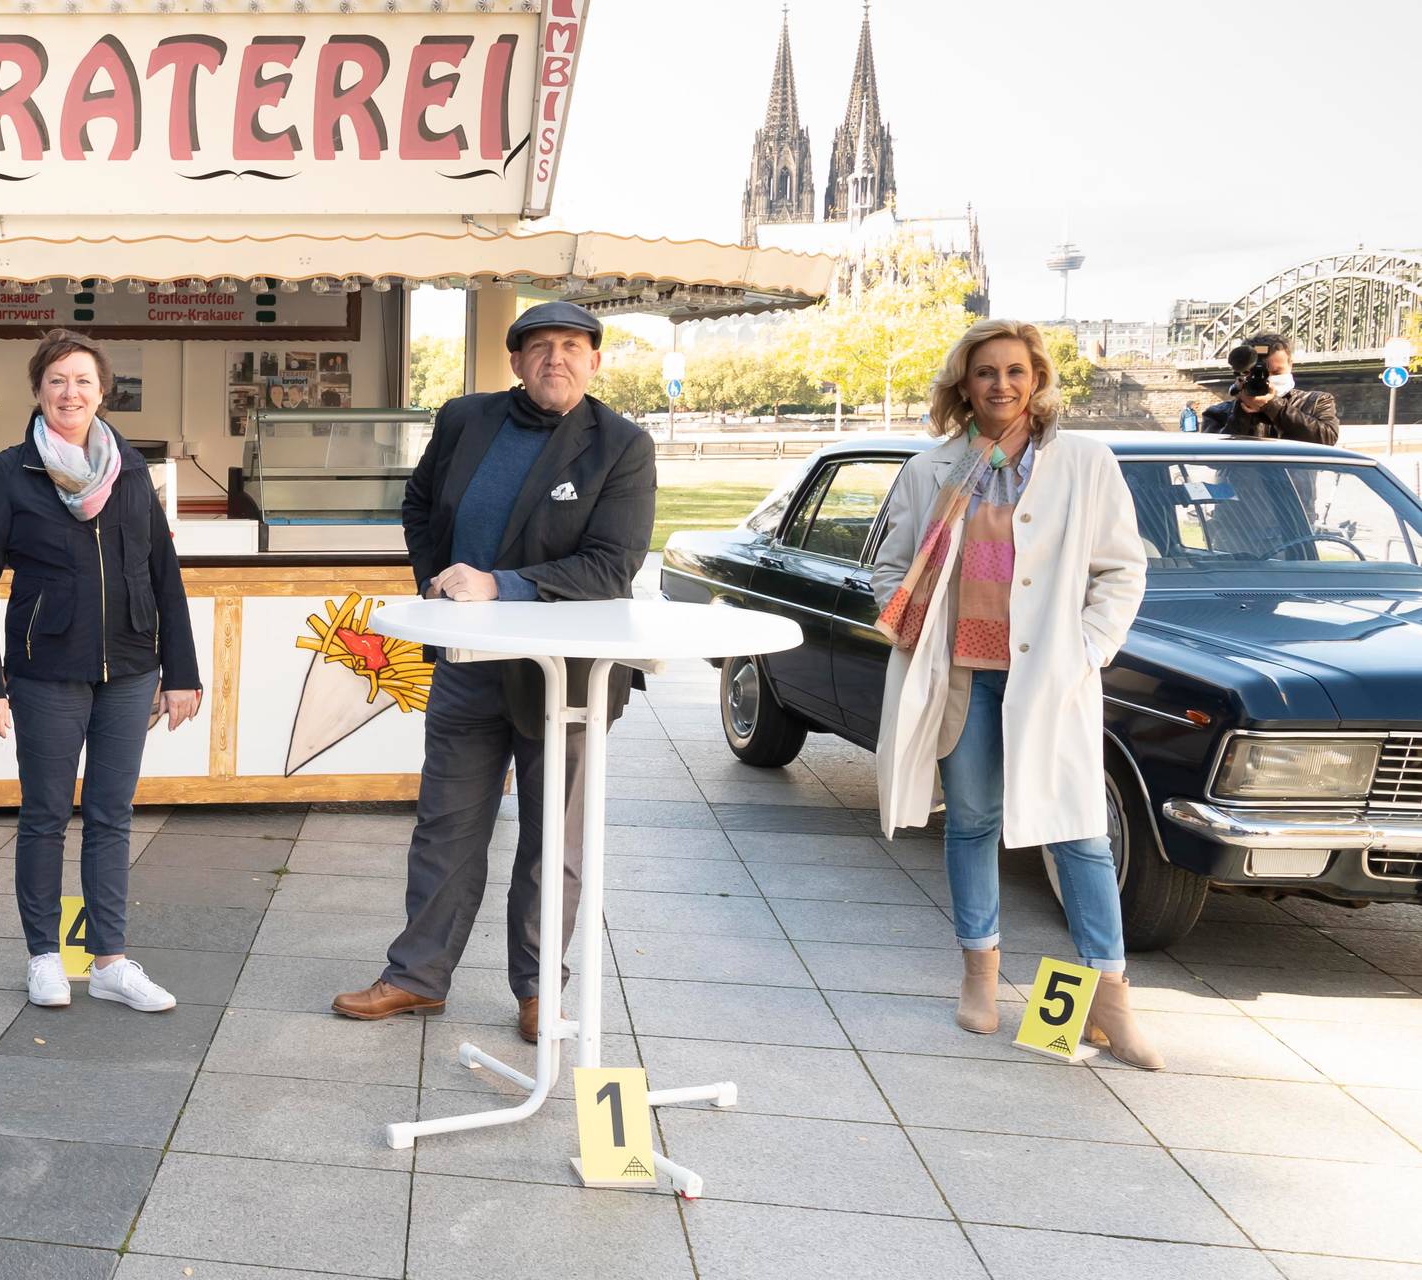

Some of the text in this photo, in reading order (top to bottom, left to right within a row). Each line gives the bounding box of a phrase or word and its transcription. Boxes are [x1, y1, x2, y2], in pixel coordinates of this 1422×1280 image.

[148, 291, 235, 305] Bratkartoffeln
[148, 308, 245, 321] Curry-Krakauer
[1038, 970, 1083, 1027] 5
[595, 1081, 626, 1148] 1
